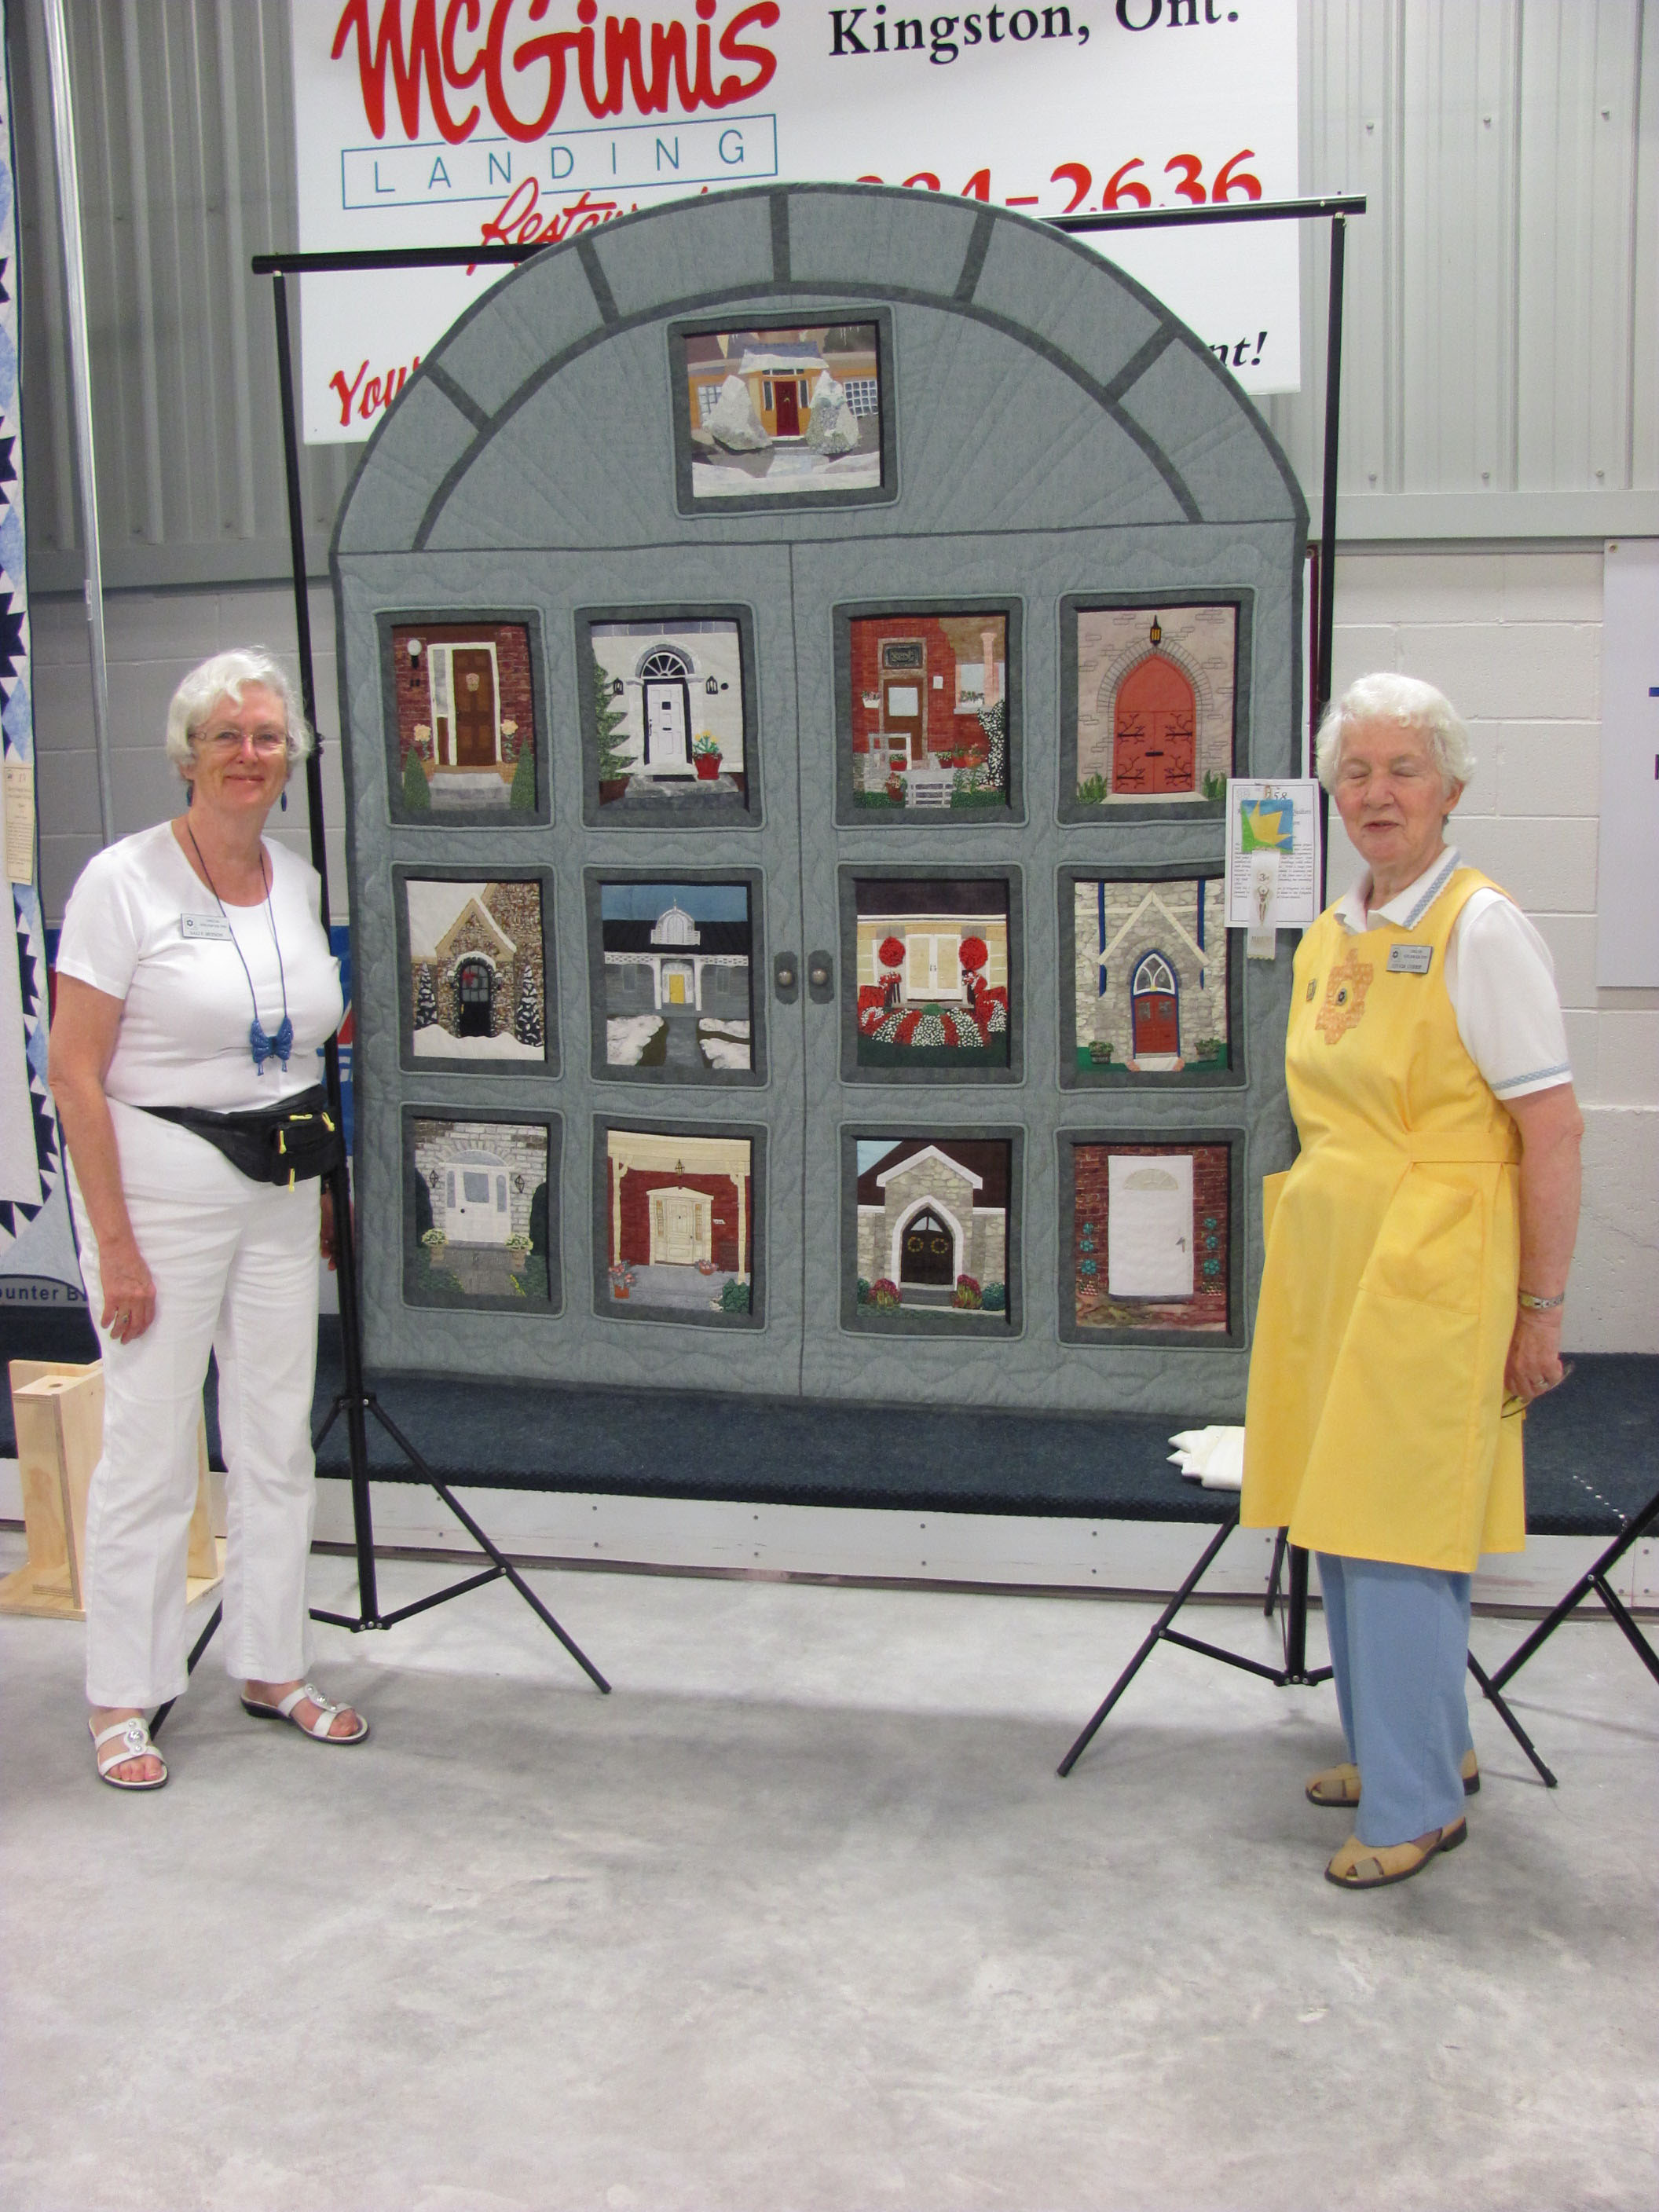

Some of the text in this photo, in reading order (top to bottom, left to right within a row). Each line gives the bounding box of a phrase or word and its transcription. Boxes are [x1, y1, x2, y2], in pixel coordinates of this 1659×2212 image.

[829, 0, 1239, 64] Kingston, Ont.
[331, 0, 780, 145] McGinnis
[374, 130, 745, 192] LANDING
